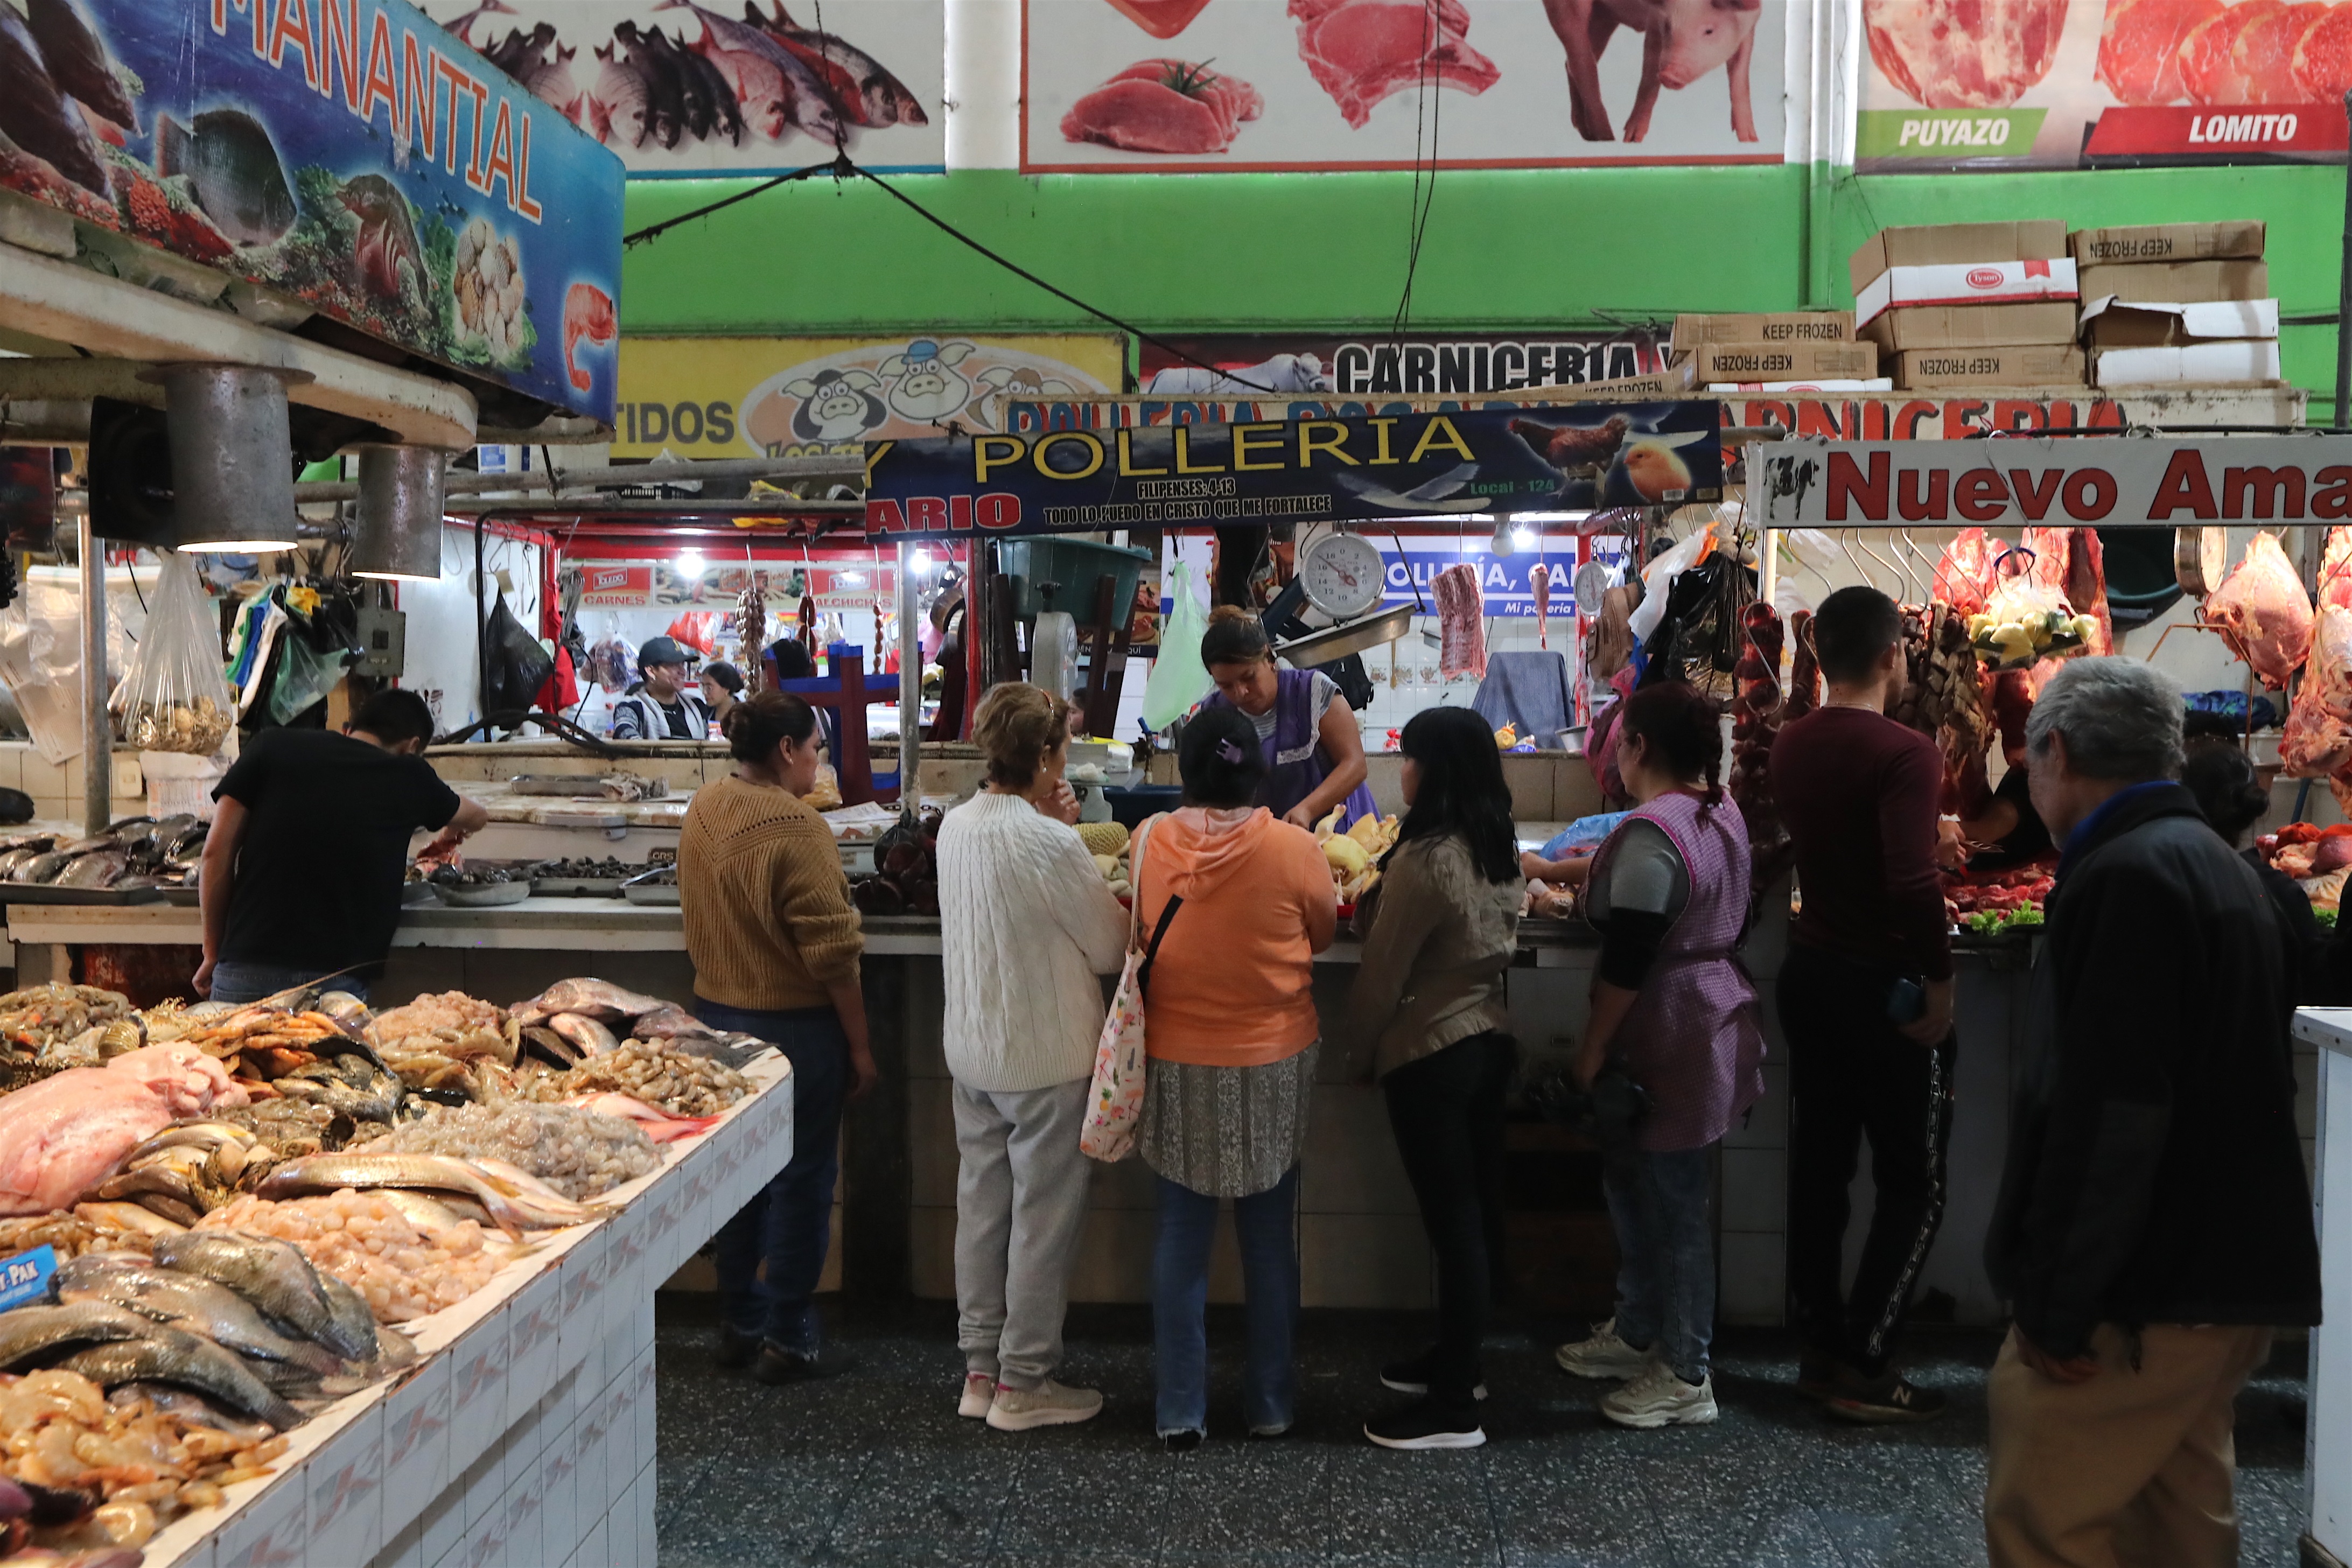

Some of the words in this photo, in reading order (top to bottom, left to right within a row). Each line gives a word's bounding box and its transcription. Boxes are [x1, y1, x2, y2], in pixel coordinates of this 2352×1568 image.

[1899, 118, 2010, 146] PUYAZO
[2188, 114, 2298, 143] LOMITO
[2090, 241, 2137, 258] FROZEN
[2140, 239, 2172, 256] KEEP
[1973, 274, 1998, 283] Tyson
[1763, 325, 1793, 339] KEEP
[1796, 323, 1842, 339] FROZEN
[1713, 355, 1759, 371] FROZEN
[1762, 355, 1791, 370] KEEP
[1920, 359, 1965, 375] FROZEN
[1969, 358, 1999, 374] KEEP
[974, 415, 1476, 484] POLLERIA
[1471, 481, 1514, 495] Local
[1528, 479, 1555, 492] 124
[1825, 450, 2118, 522] Nuevo
[1044, 507, 1077, 525] TODO
[1081, 506, 1098, 523] LO
[1100, 504, 1142, 522] PUEDO
[1145, 502, 1161, 520] EN
[1165, 501, 1211, 519] CRISTO
[1214, 499, 1239, 518] QUE
[1242, 498, 1263, 516] ME
[1265, 494, 1332, 515] FORTALECE
[584, 595, 645, 605] CARNES
[816, 598, 893, 608] ALCHICHS
[1504, 602, 1521, 613] Mi
